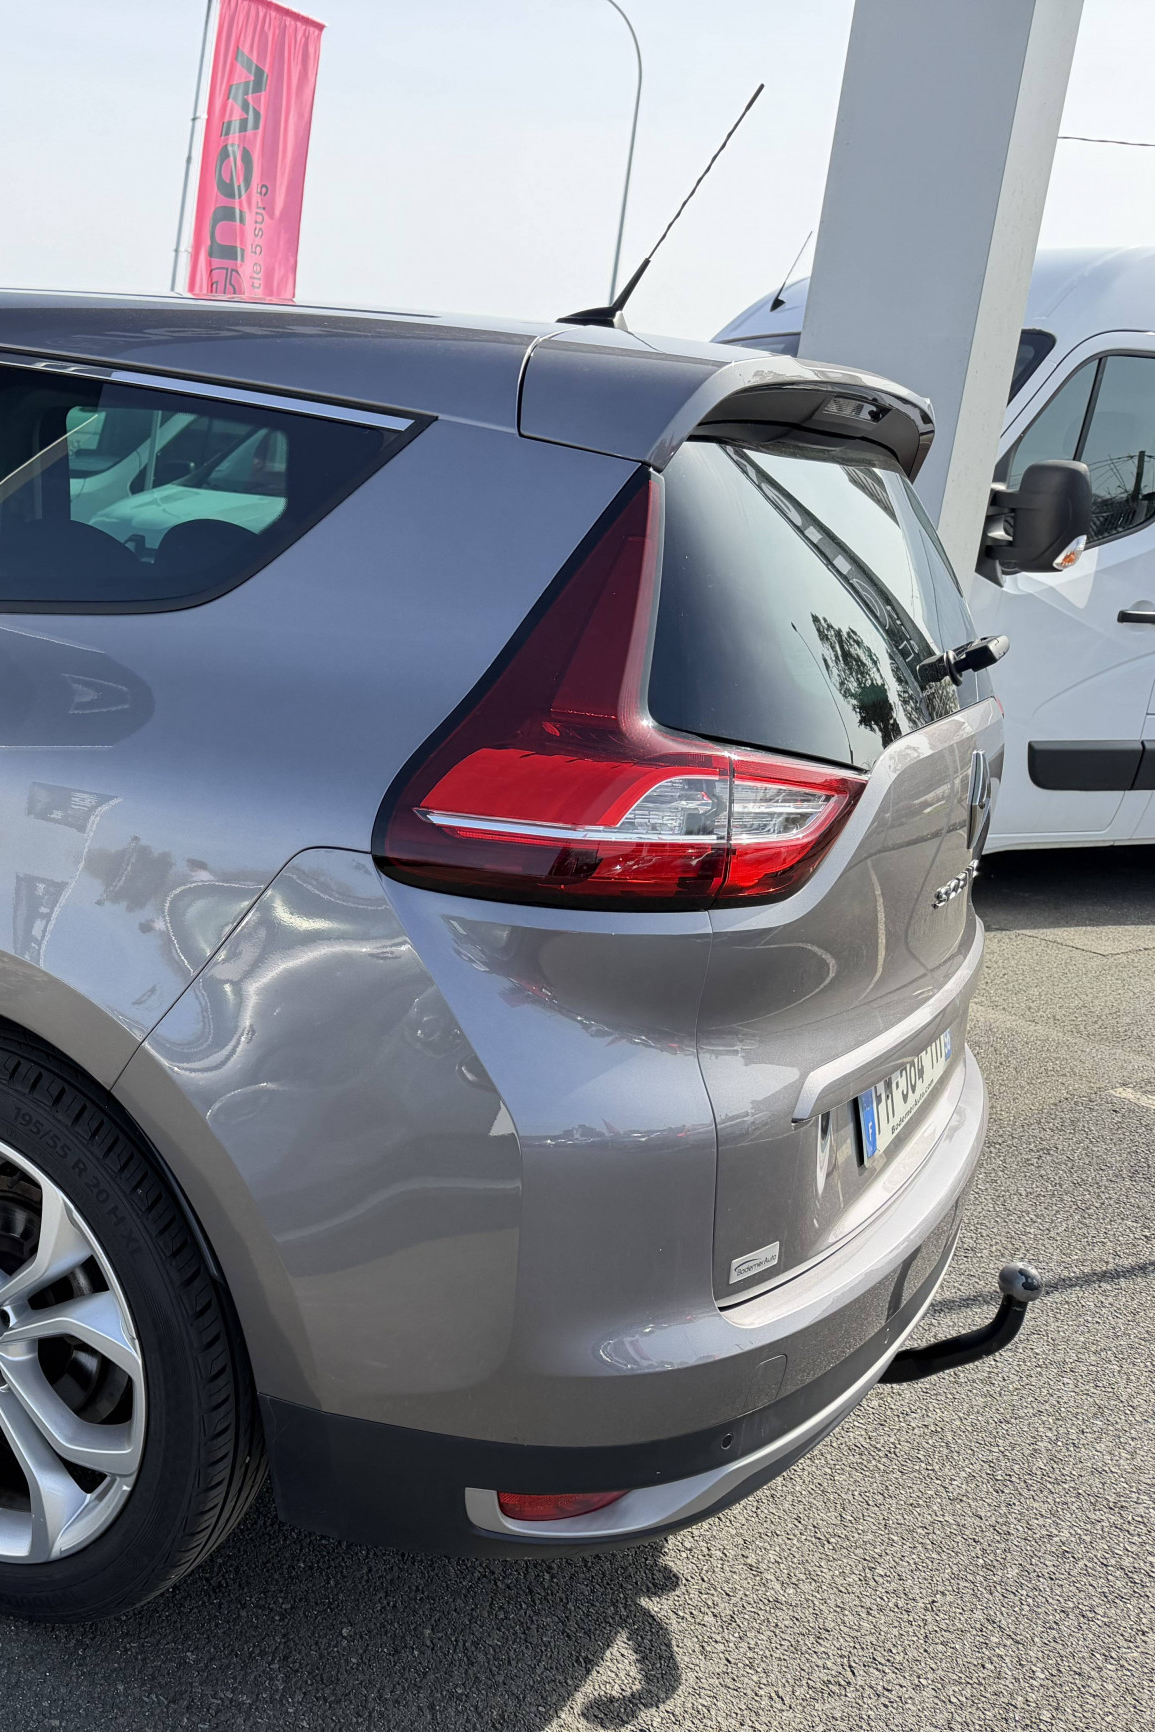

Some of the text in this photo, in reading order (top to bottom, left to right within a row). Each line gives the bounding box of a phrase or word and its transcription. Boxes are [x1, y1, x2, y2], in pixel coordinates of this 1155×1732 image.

[256, 183, 269, 197] 5
[254, 202, 266, 240] sur
[250, 242, 263, 258] 5
[13, 1105, 73, 1160] 195/55
[71, 1159, 89, 1178] R
[85, 1179, 110, 1204] 20
[737, 1254, 777, 1277] BodemerAuto
